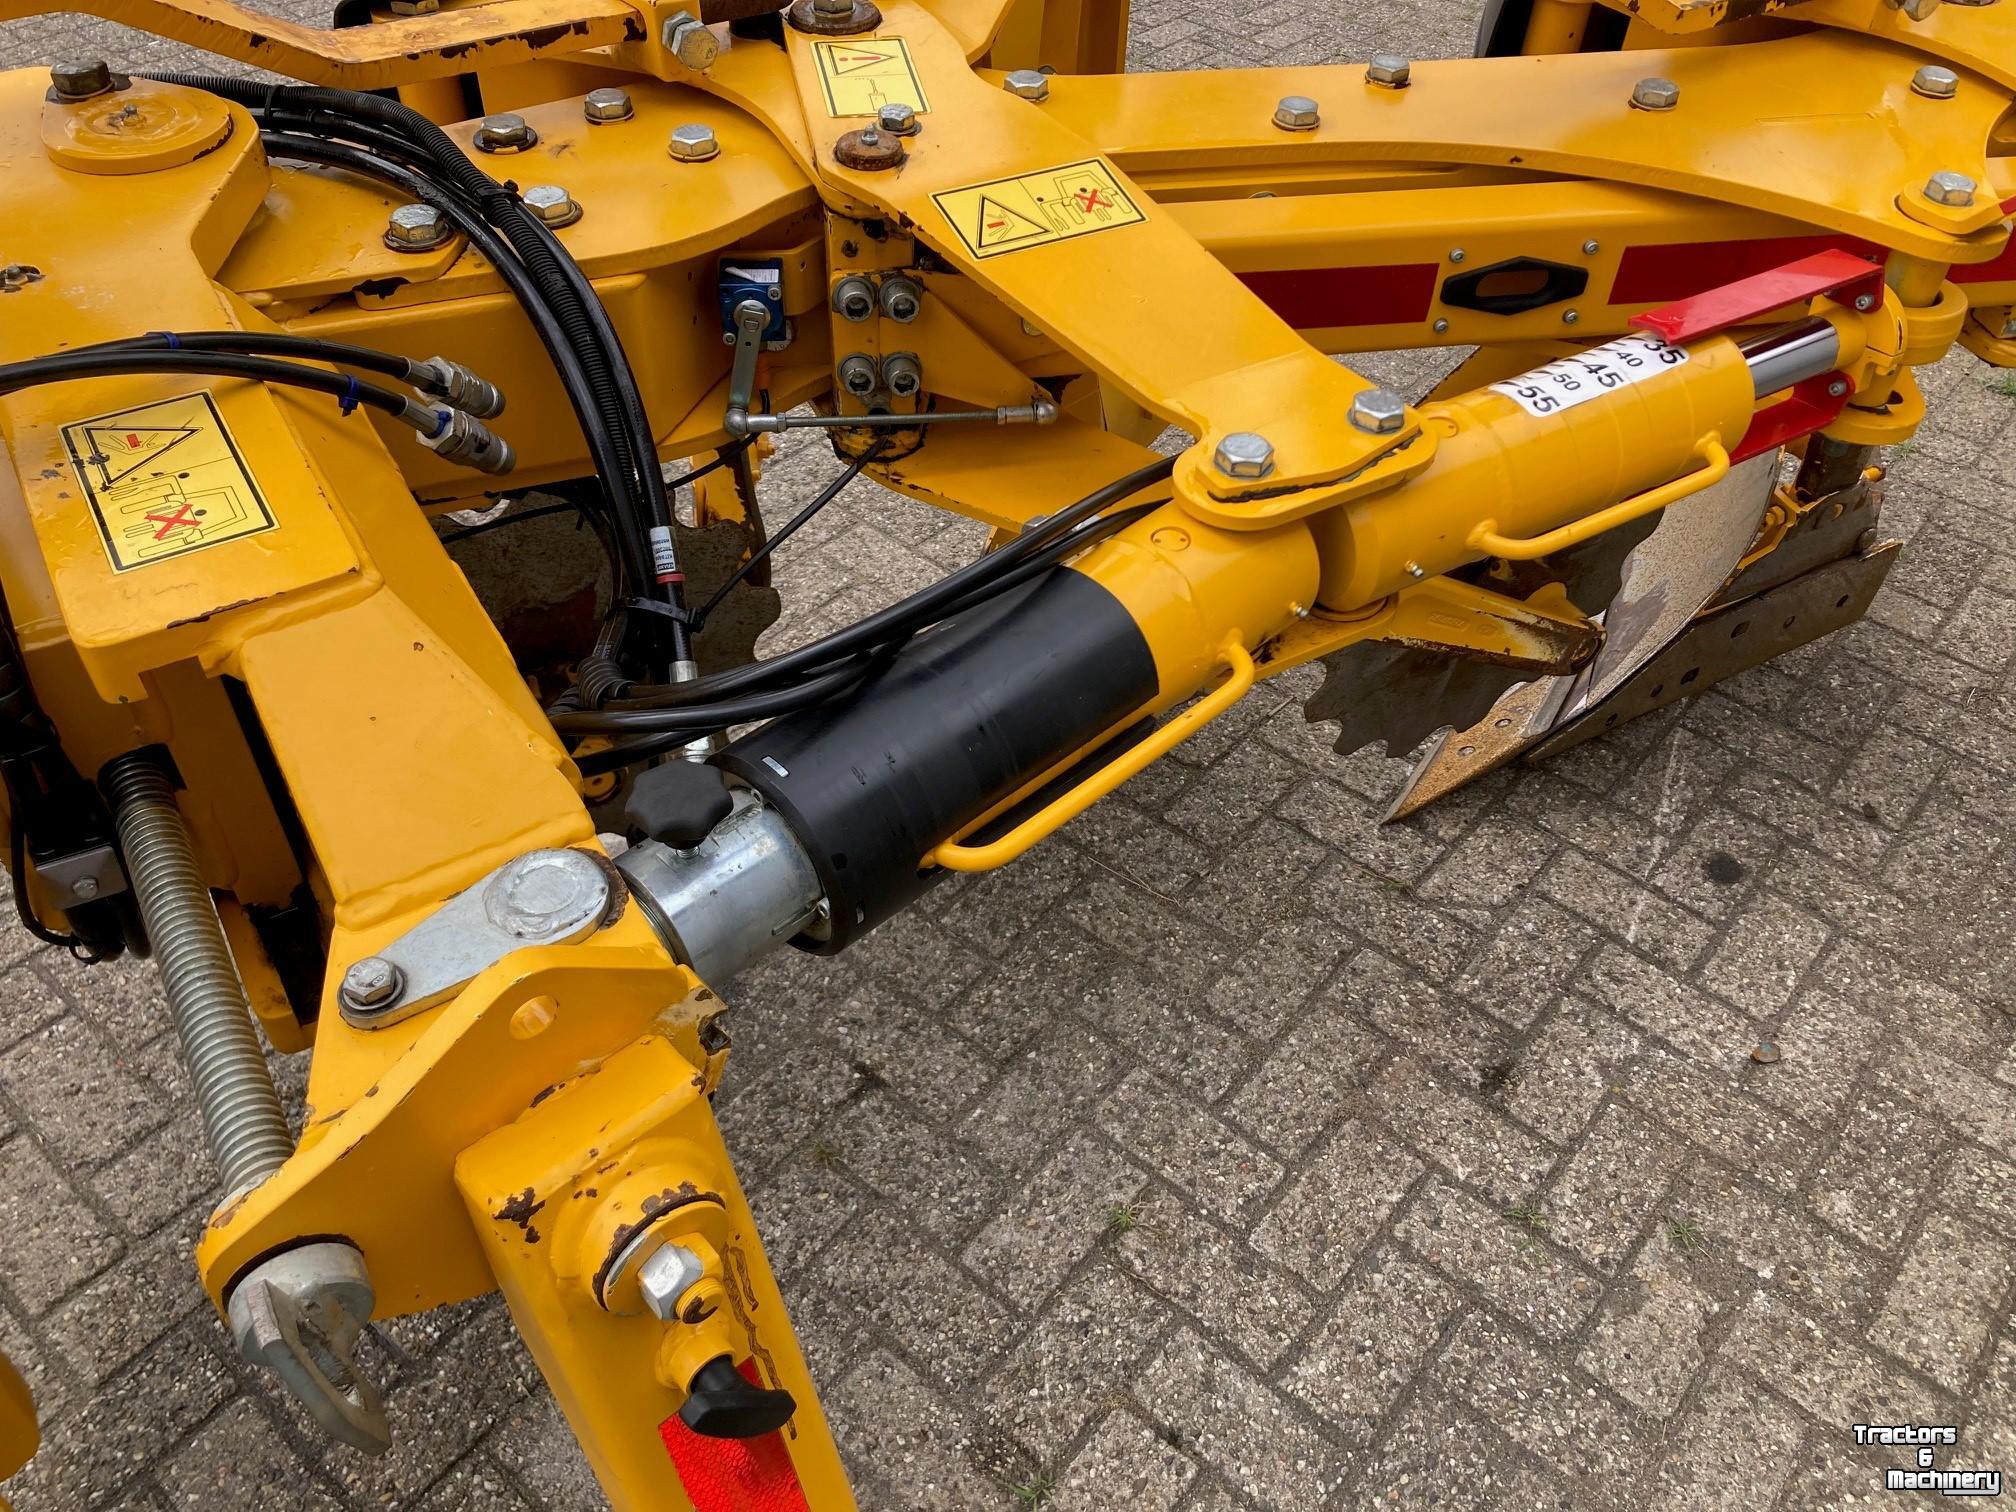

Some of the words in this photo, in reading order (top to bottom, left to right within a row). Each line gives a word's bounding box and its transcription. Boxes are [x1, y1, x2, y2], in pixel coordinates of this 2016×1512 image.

[1617, 350, 1643, 368] 40
[1645, 339, 1685, 364] 35
[1553, 373, 1581, 391] 50
[1584, 363, 1624, 388] 45
[1518, 385, 1560, 412] 55
